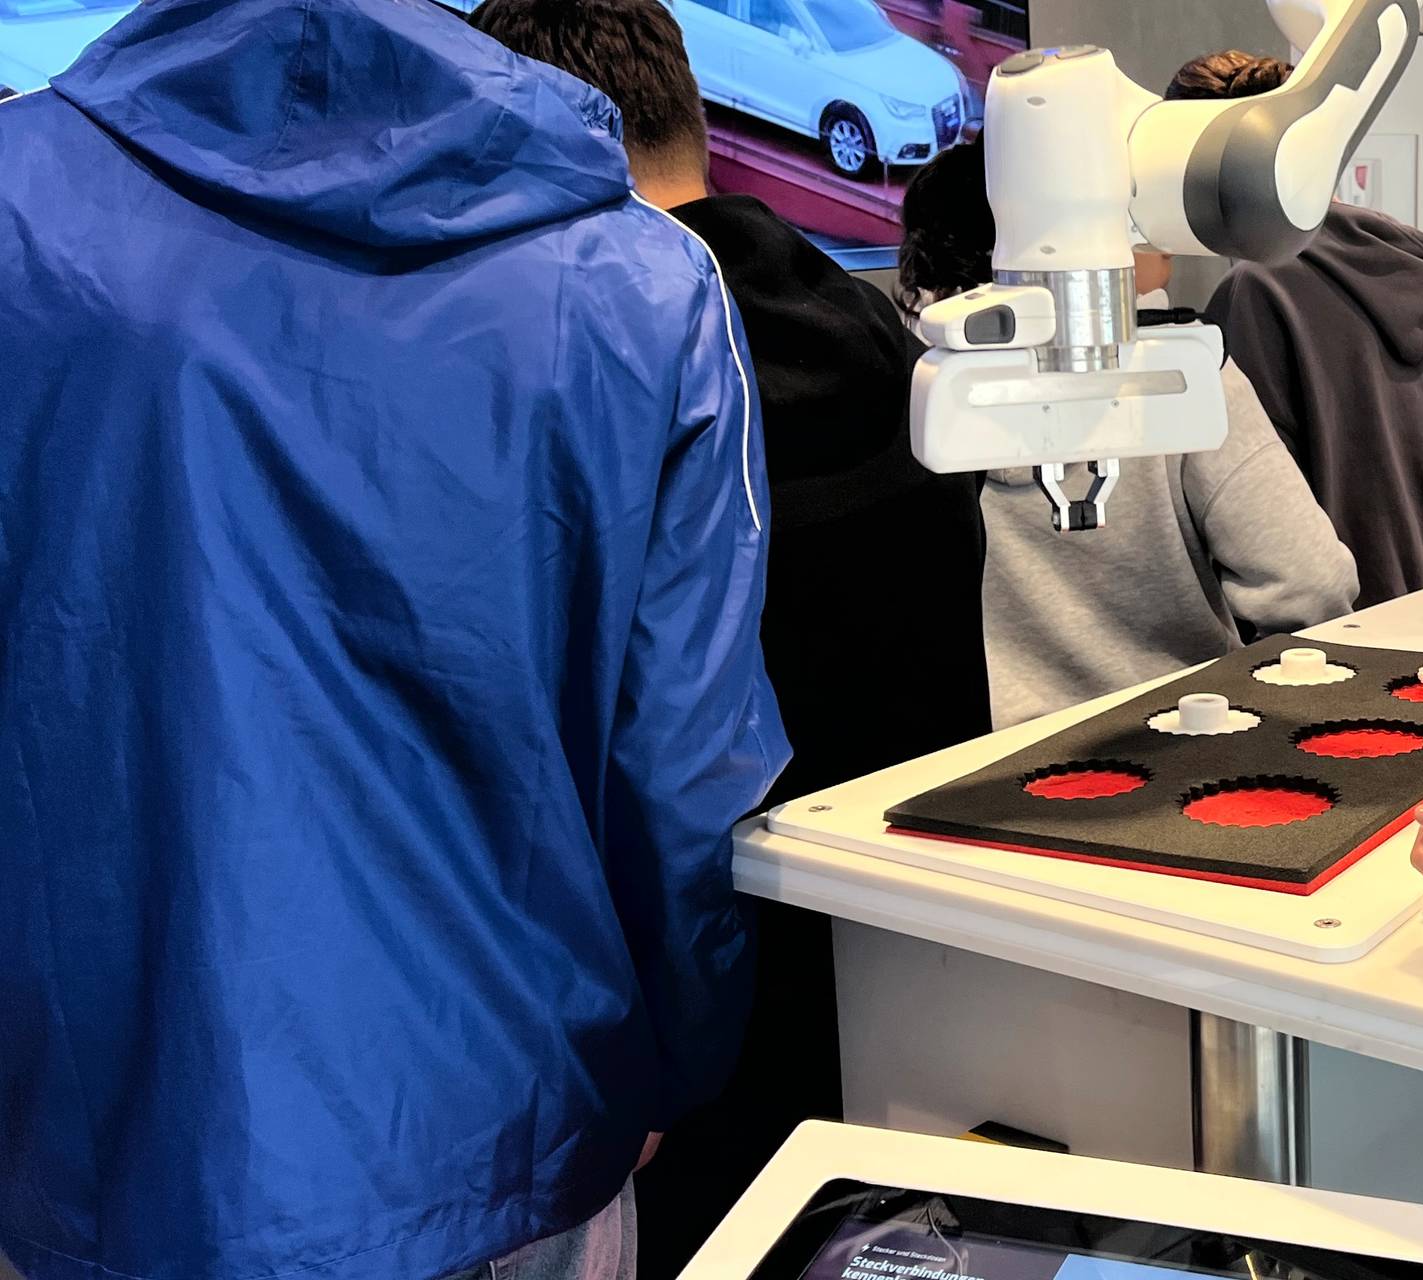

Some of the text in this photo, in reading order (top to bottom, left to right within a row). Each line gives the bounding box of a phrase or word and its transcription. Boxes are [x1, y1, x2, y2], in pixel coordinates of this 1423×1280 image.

[872, 1245, 897, 1255] Stecker
[896, 1248, 911, 1257] und
[850, 1256, 985, 1280] Steckverbindun
